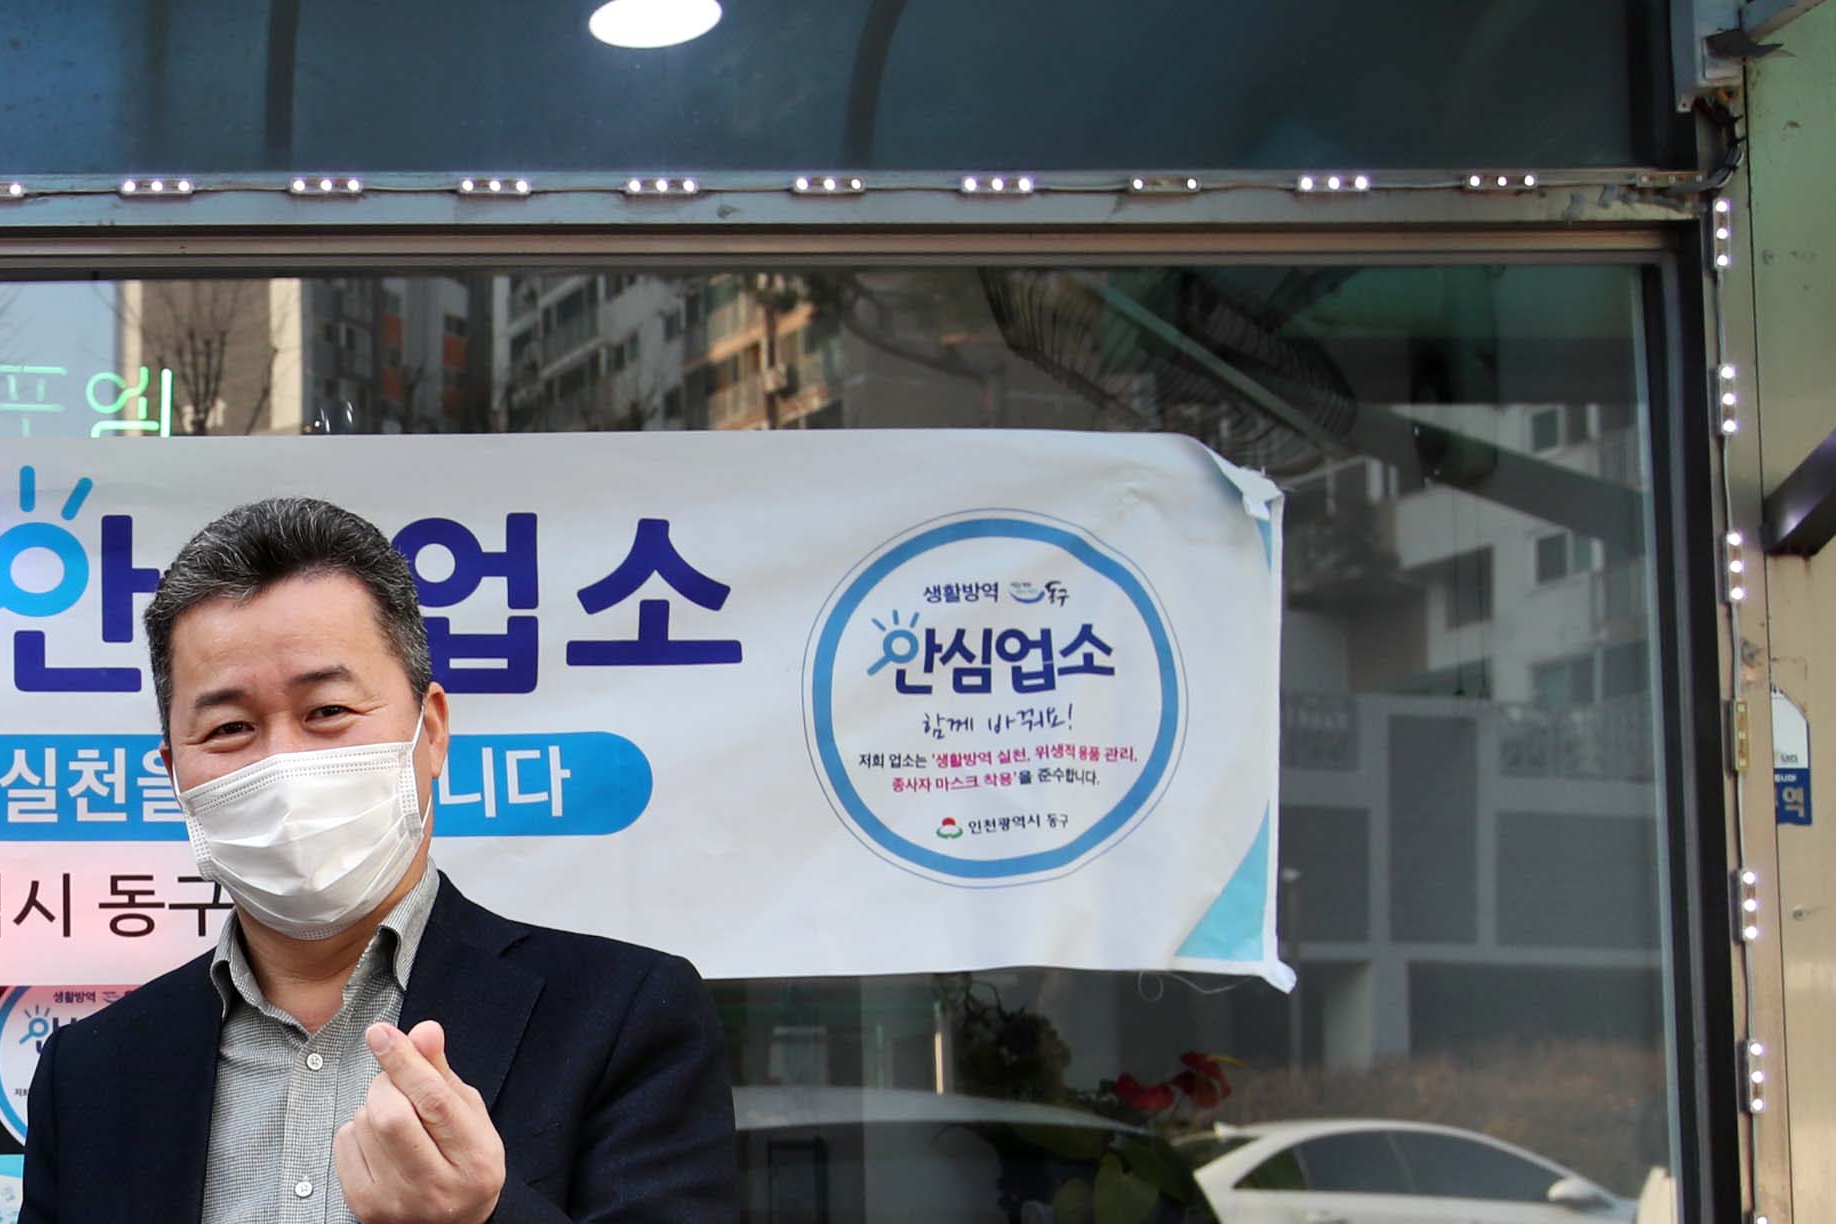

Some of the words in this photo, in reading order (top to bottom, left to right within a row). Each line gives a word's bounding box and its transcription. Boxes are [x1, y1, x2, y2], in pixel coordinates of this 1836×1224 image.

[924, 581, 999, 604] 생활방역
[867, 622, 1115, 695] 안심업소
[923, 712, 974, 739] 함께
[859, 753, 885, 769] 저희
[889, 753, 927, 769] 업소는
[1035, 744, 1076, 761] 위생적
[892, 777, 931, 793] 종사자
[935, 776, 980, 792] 마스크
[968, 813, 1041, 836] 인천광역시
[1047, 812, 1069, 829] 동구
[98, 874, 235, 938] 동구
